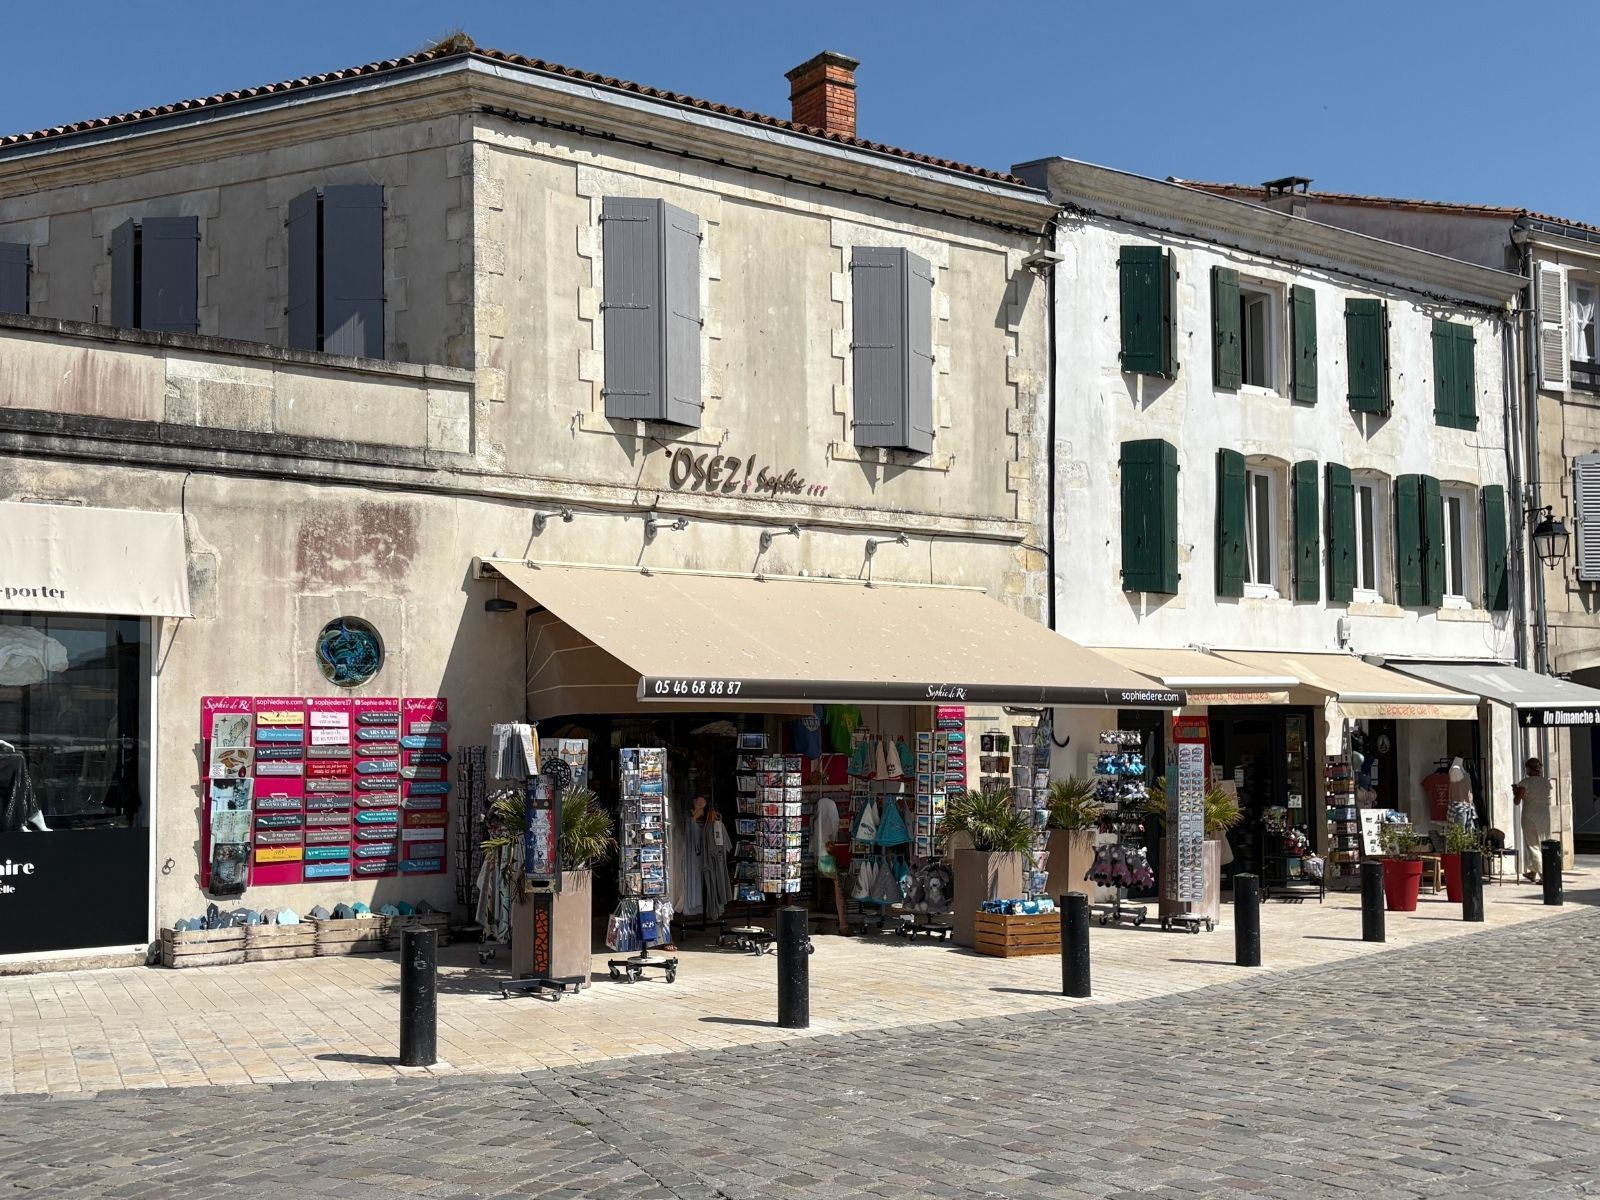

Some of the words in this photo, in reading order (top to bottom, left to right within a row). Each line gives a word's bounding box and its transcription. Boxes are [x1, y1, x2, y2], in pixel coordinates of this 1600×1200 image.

[655, 679, 670, 694] 05
[673, 680, 688, 695] 46
[691, 680, 706, 694] 68
[709, 681, 724, 694] 88
[727, 681, 741, 695] 87
[926, 683, 948, 701] Sophie
[1121, 690, 1180, 702] sophiedere.com
[204, 697, 230, 712] Sophie
[405, 698, 427, 713] Sophie
[1543, 711, 1554, 725] Un
[1555, 710, 1594, 725] Dimanche
